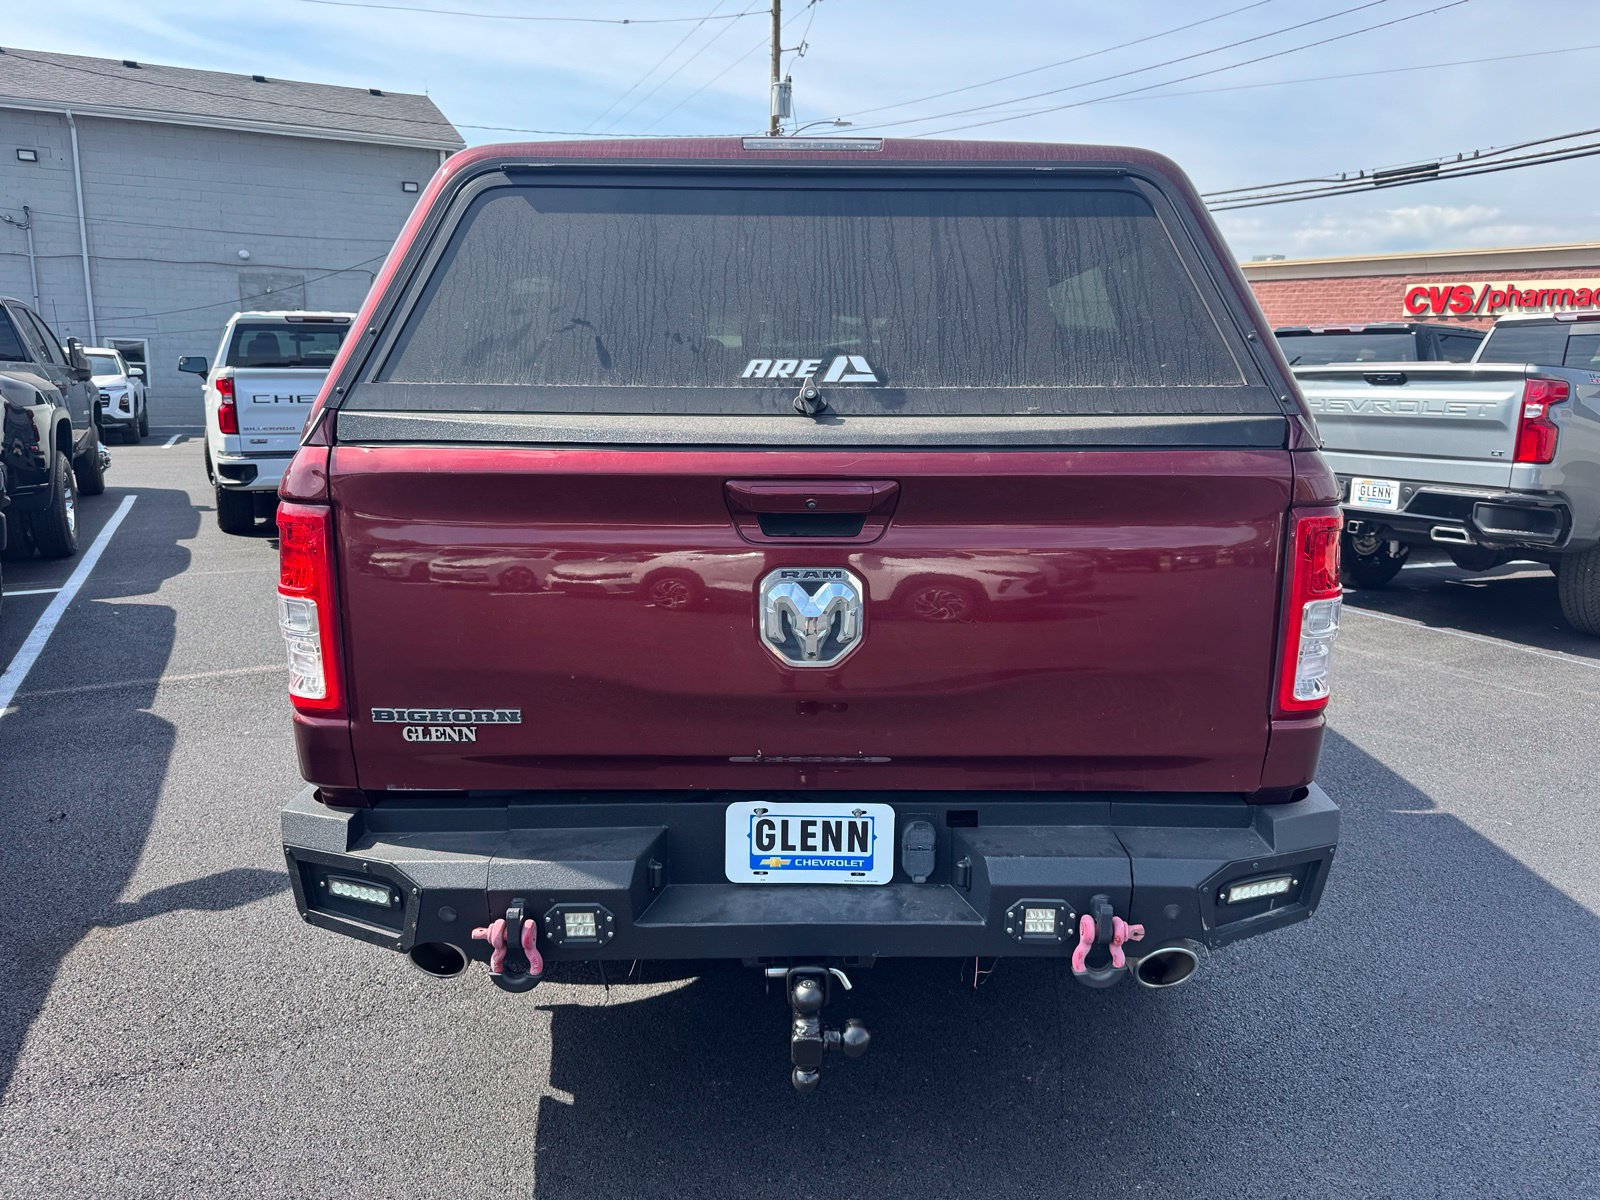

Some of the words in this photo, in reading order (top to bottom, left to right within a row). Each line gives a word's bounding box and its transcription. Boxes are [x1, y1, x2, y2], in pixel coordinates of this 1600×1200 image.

[741, 358, 823, 379] ARE
[1306, 397, 1498, 417] HEVROLET
[1360, 485, 1391, 499] GLENN
[780, 571, 842, 579] RAM
[371, 708, 522, 724] BIGHORN
[402, 726, 477, 742] GLENN
[755, 819, 869, 853] GLENN
[794, 858, 865, 868] CHEVROLET
